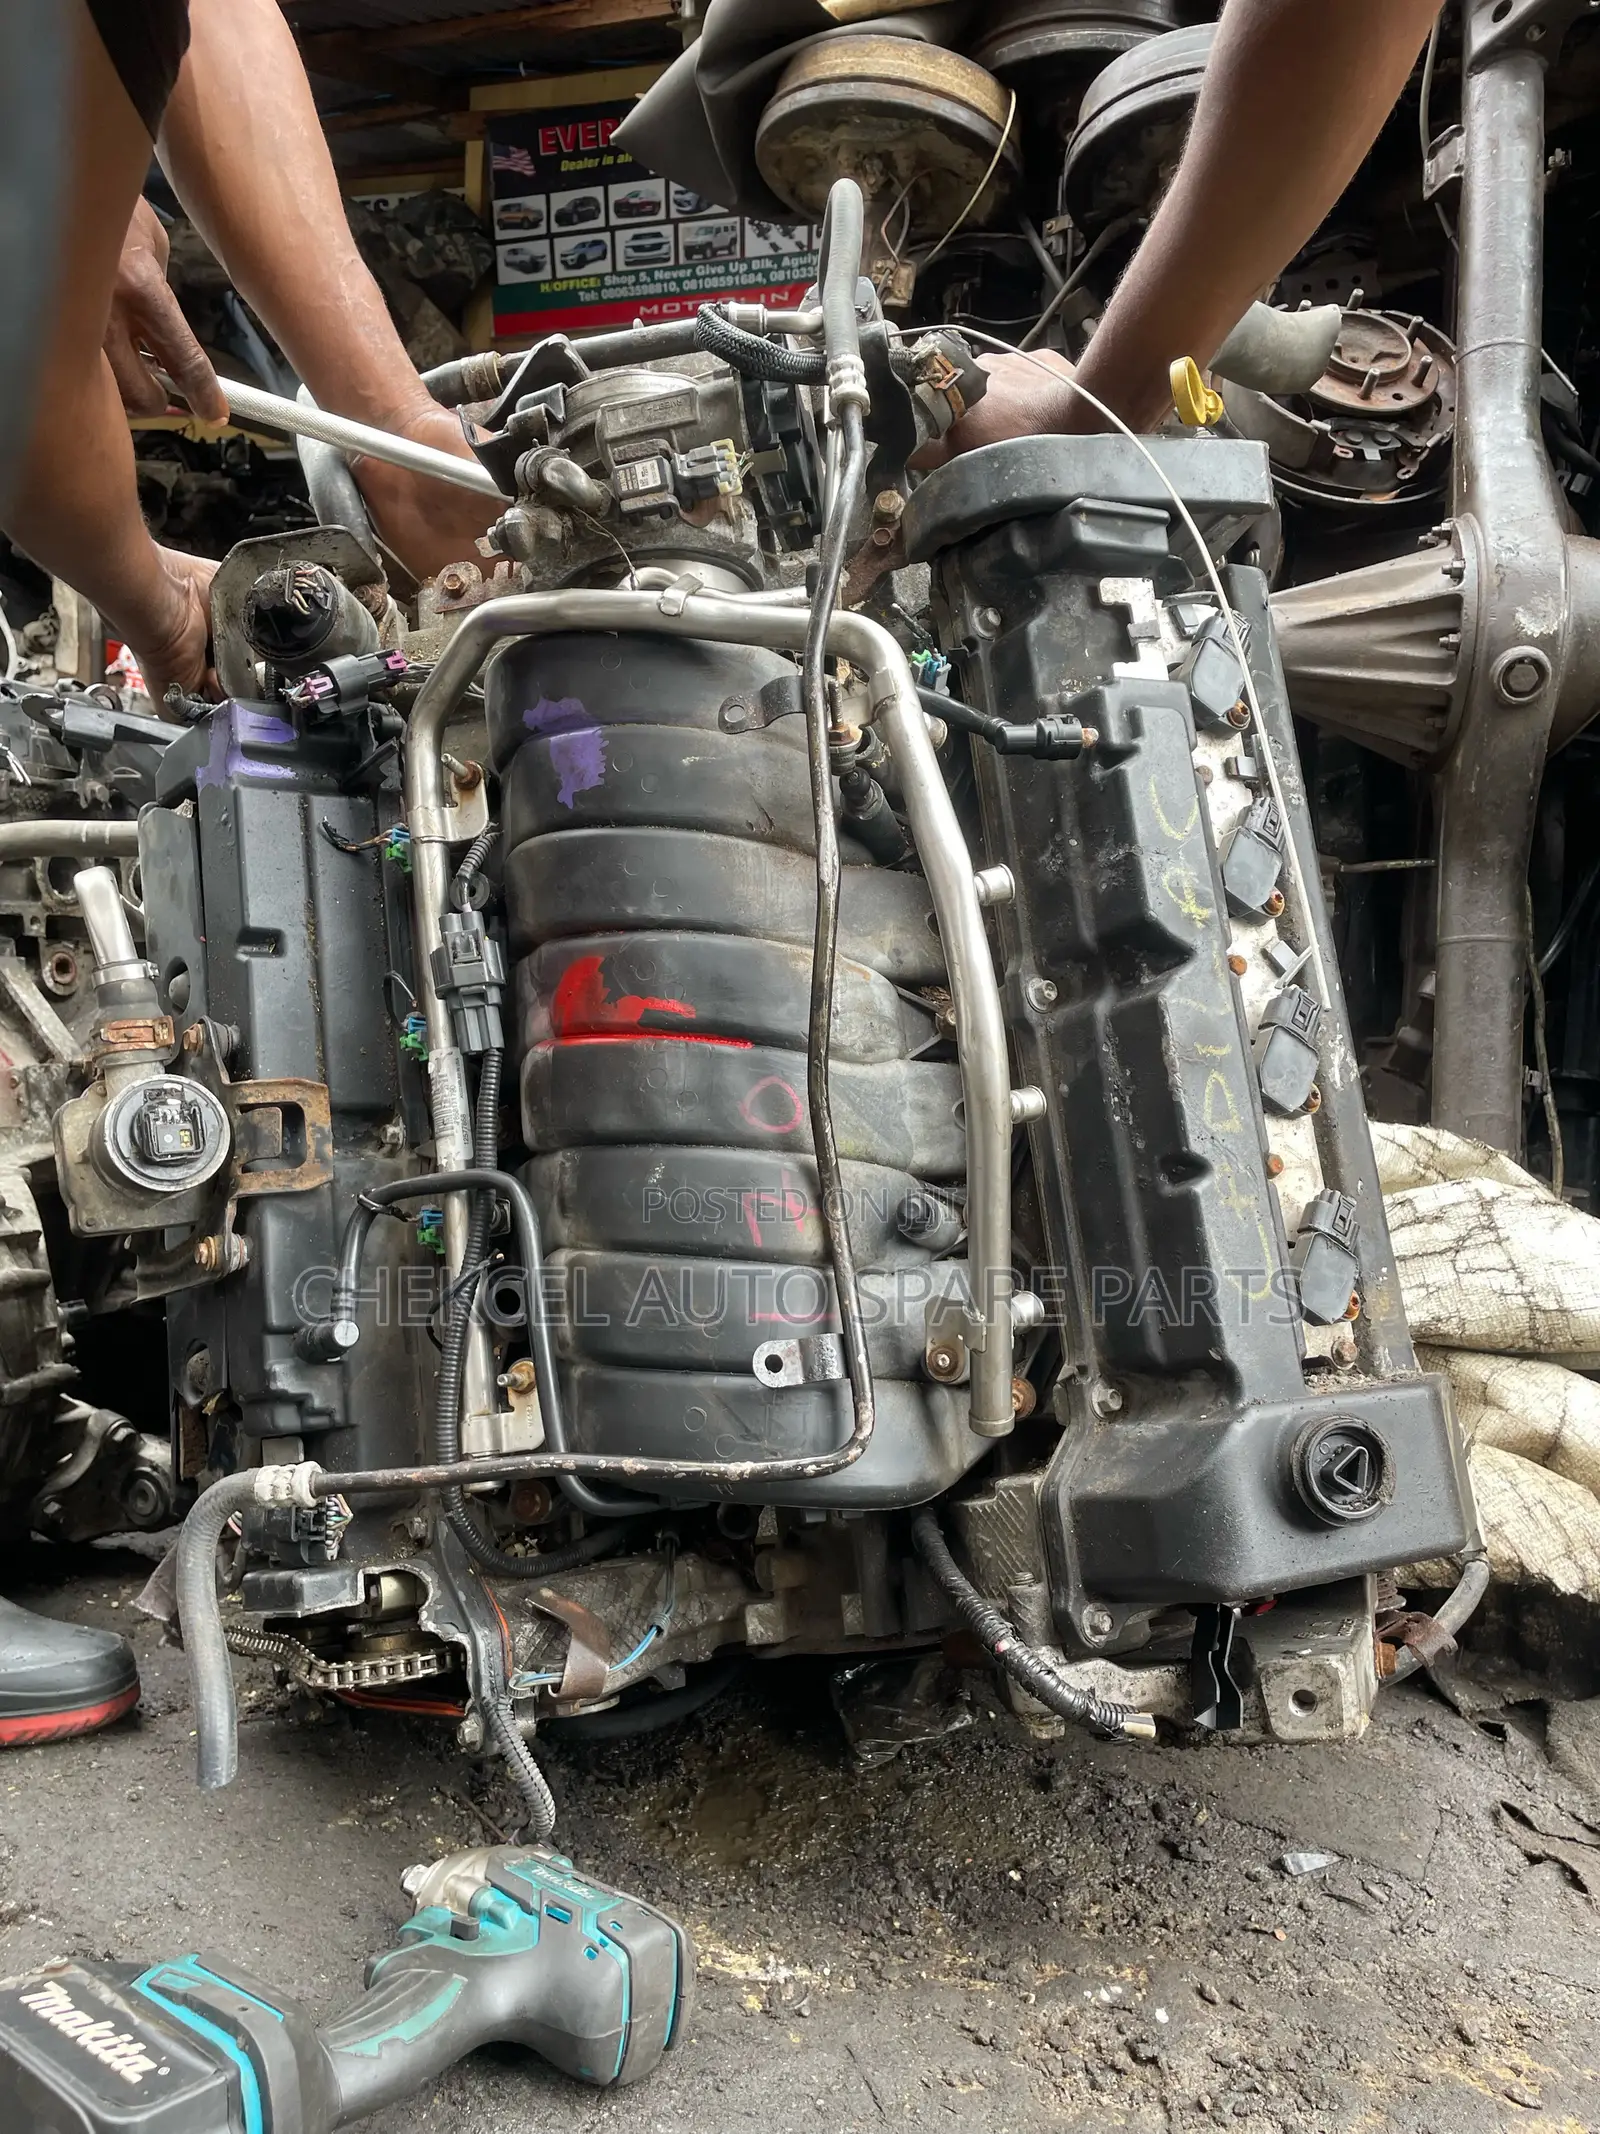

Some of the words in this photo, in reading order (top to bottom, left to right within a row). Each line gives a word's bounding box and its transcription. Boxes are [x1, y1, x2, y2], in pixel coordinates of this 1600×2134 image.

[561, 157, 600, 171] Dealer
[602, 154, 614, 165] in
[604, 272, 636, 286] Shop
[654, 268, 692, 280] Never
[695, 264, 725, 276] Give
[729, 261, 747, 274] Up
[578, 290, 599, 302] Tel:
